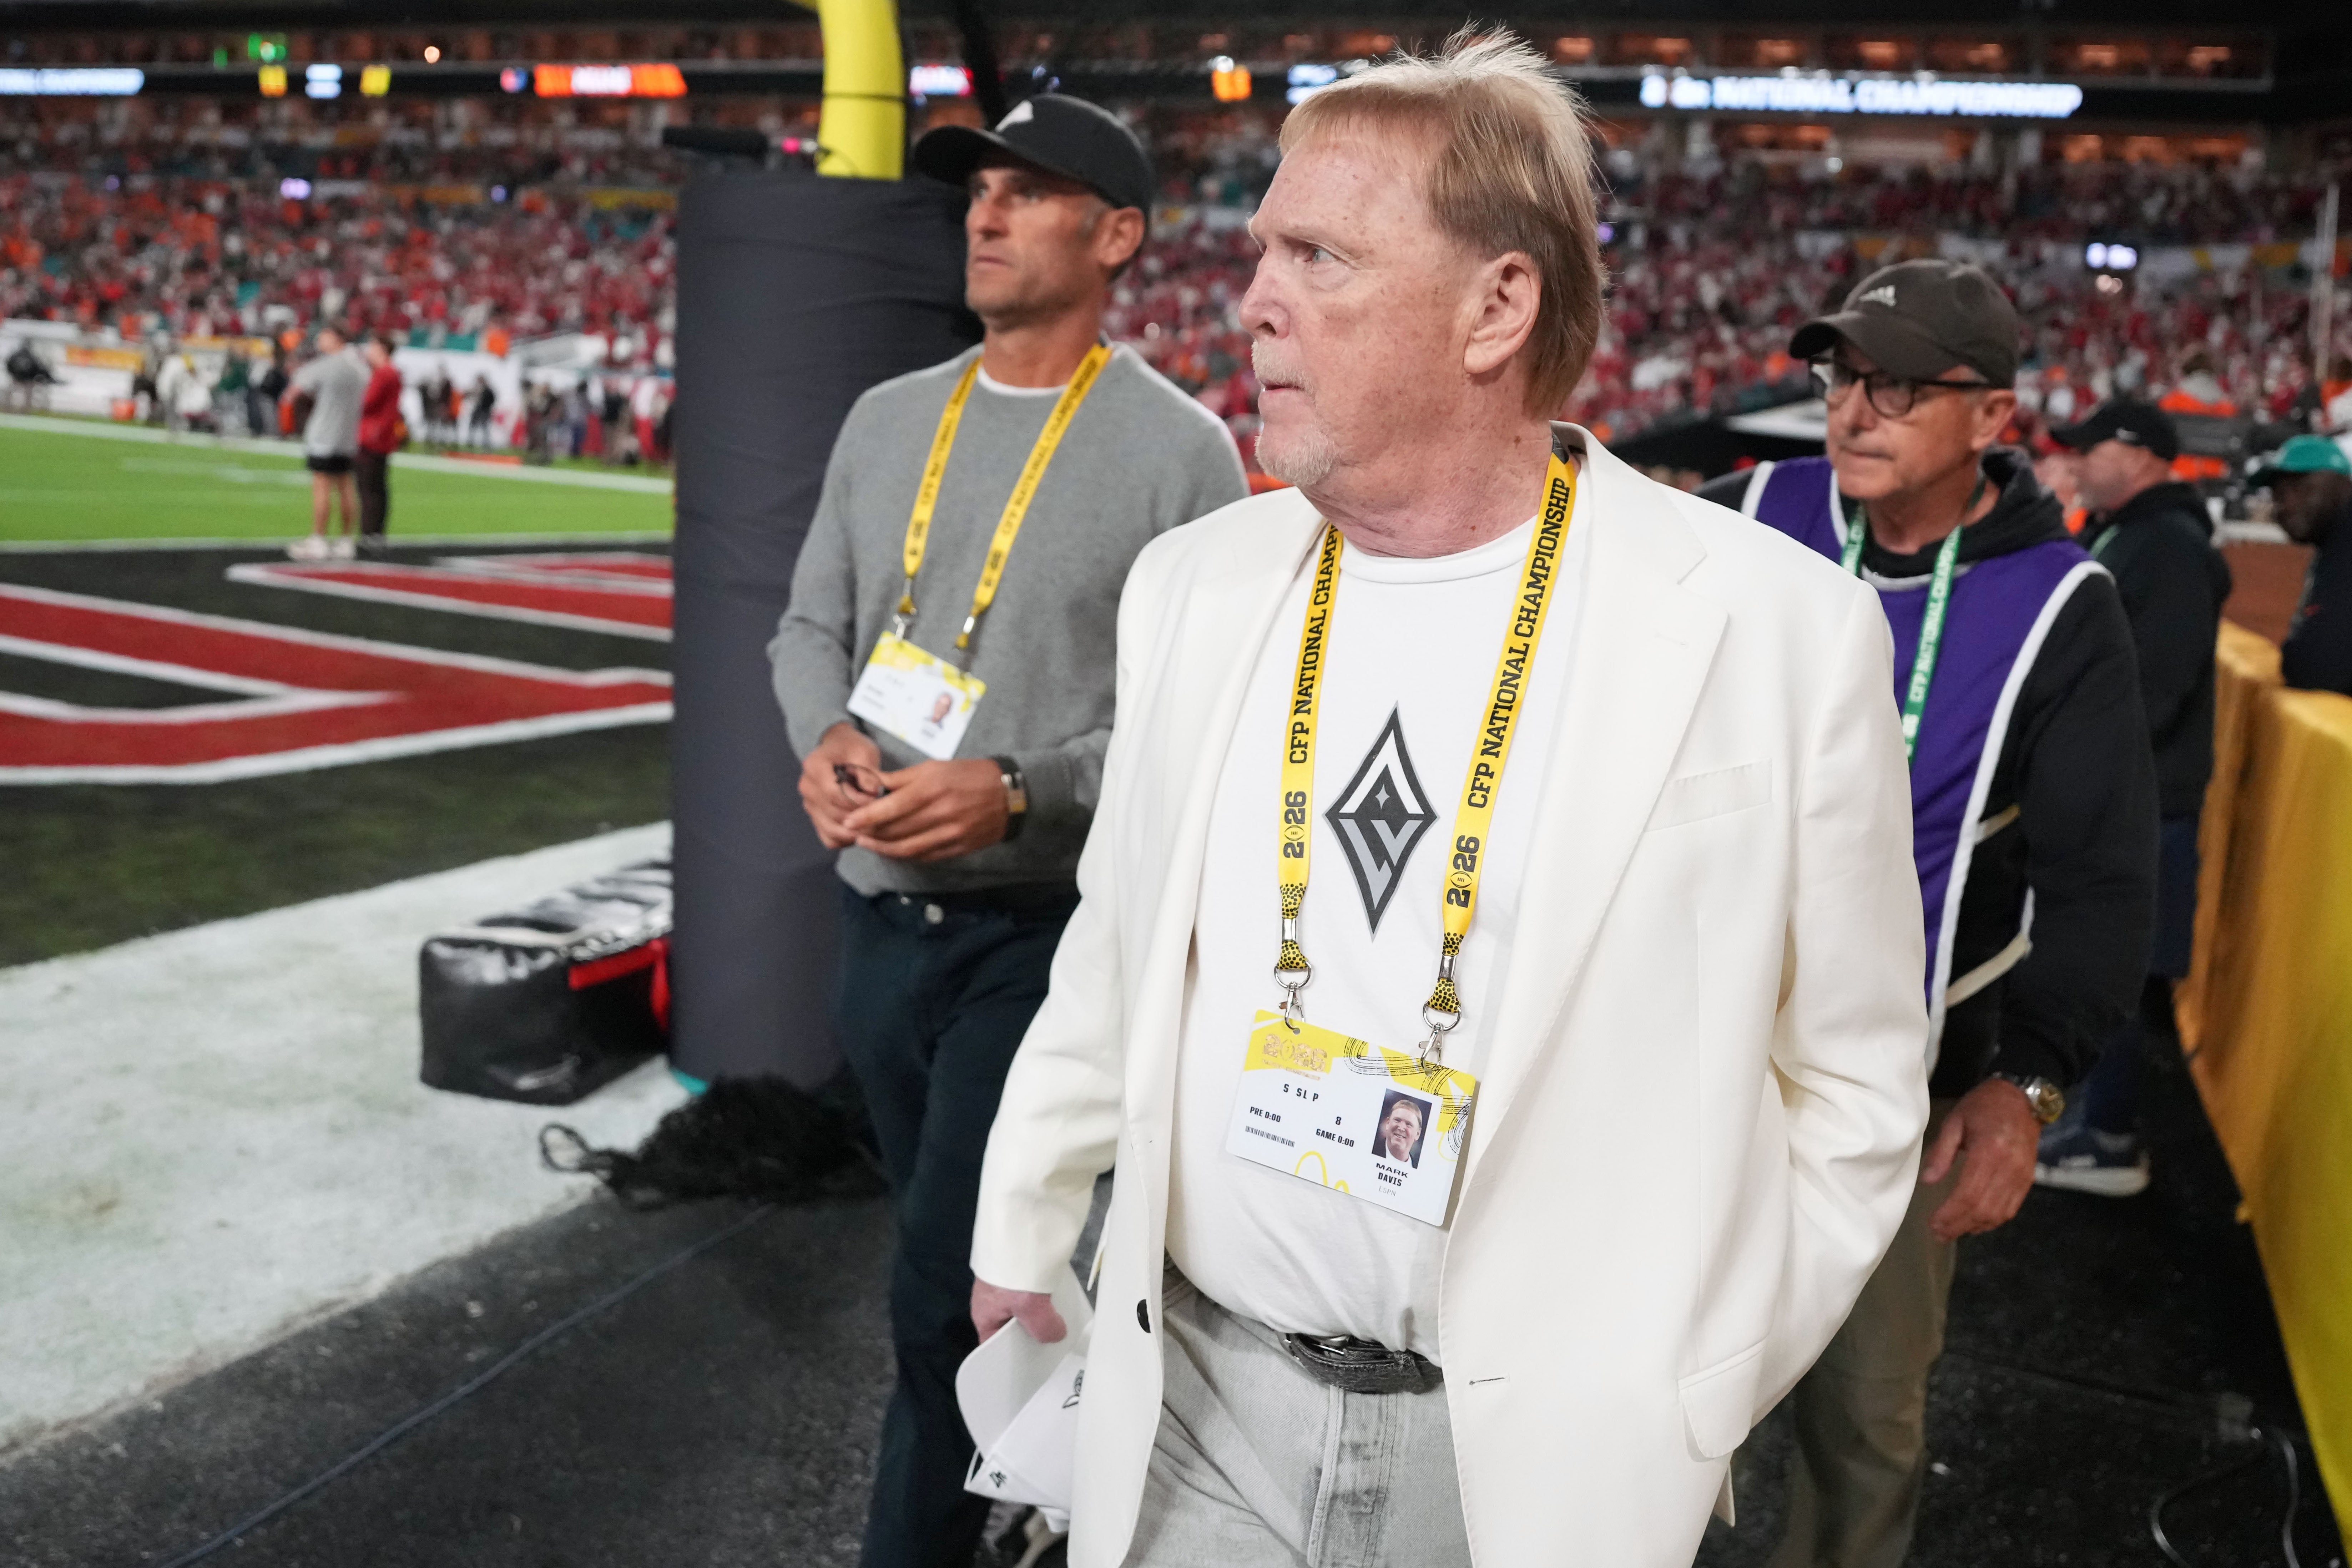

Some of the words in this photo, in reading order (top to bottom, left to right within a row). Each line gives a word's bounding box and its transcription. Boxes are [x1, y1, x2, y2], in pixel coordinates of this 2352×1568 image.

[1514, 477, 1571, 638] CHAMPIONSHIP
[1293, 609, 1327, 715] NATIONAL
[1480, 642, 1530, 759] NATIONAL
[1289, 722, 1310, 765] CFP
[1468, 762, 1496, 809] CFP
[1283, 1084, 1289, 1093] S
[1312, 1093, 1319, 1102] P
[1250, 1106, 1263, 1117] PRE
[1265, 1111, 1281, 1122] 0:00
[1335, 1116, 1342, 1125] 8
[1316, 1128, 1336, 1141] GAME
[1338, 1135, 1354, 1147] 0:00
[1376, 1163, 1408, 1178] MARK
[1378, 1172, 1402, 1186] DAVIS
